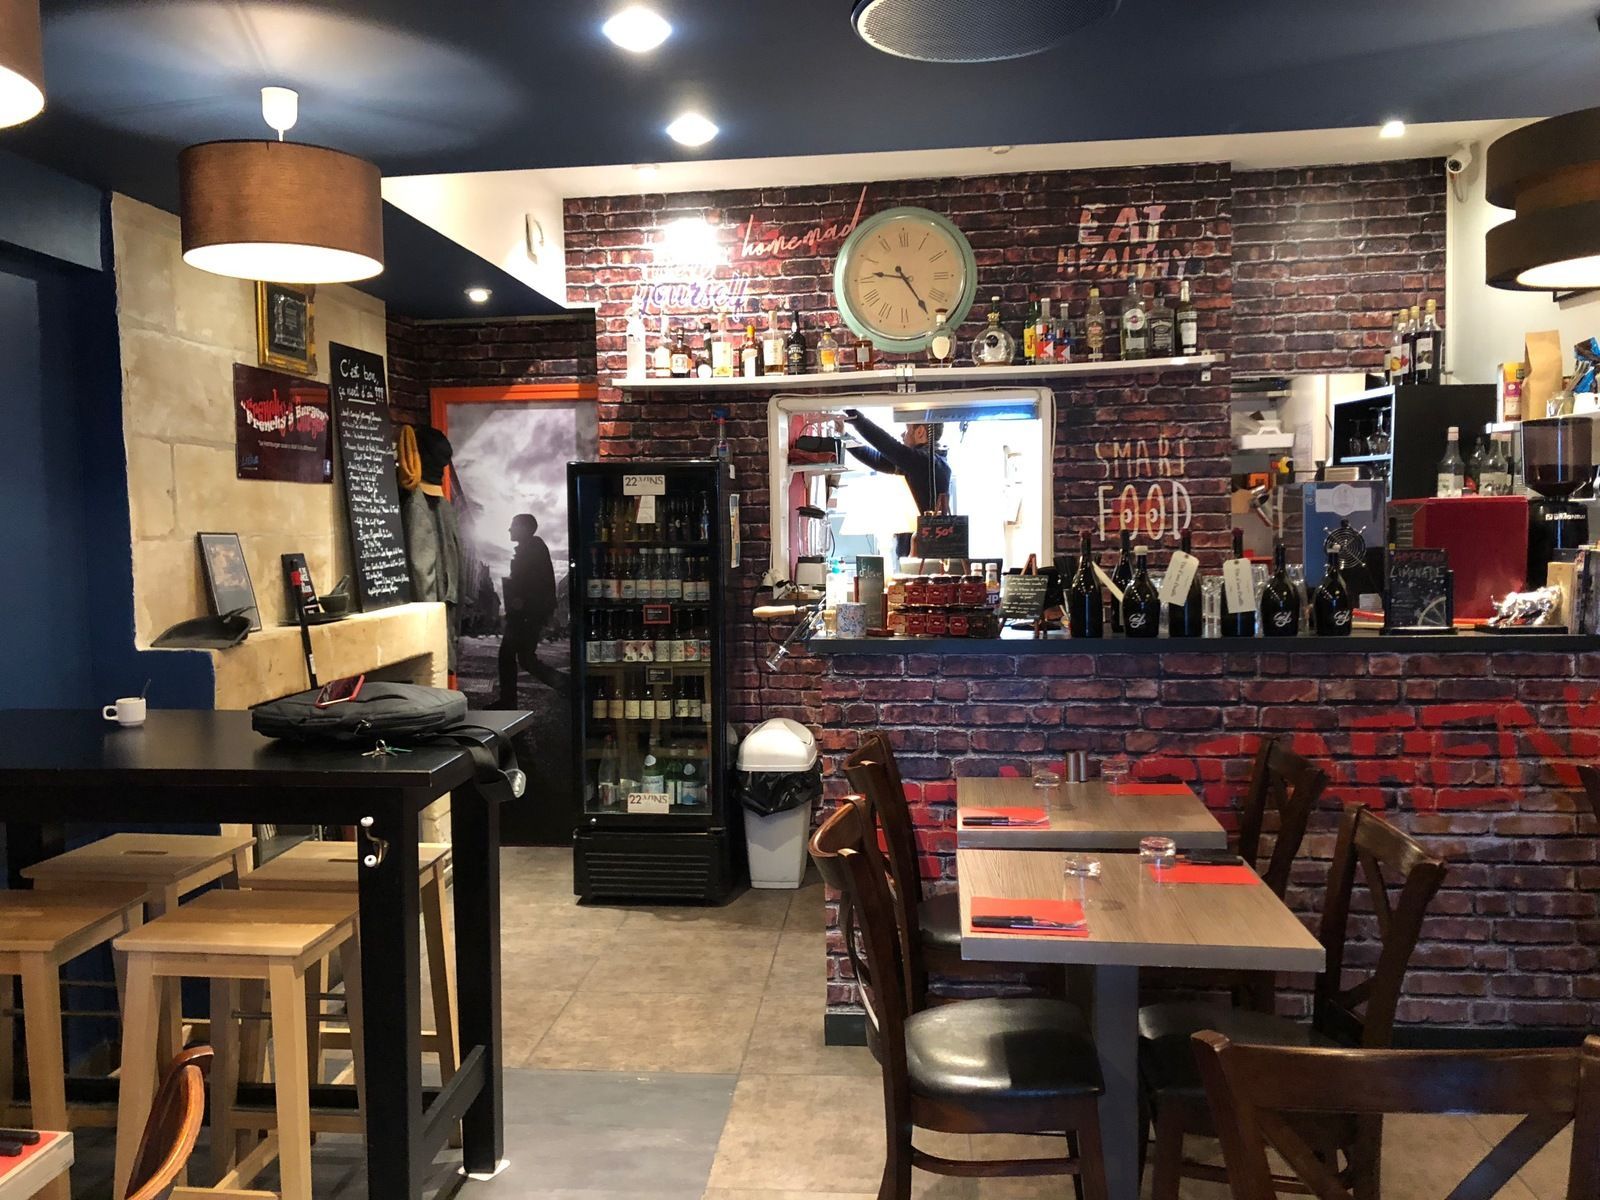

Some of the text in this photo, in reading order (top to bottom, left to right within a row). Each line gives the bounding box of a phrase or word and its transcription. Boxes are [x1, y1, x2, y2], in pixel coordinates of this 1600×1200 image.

[741, 185, 869, 257] homemad
[1078, 205, 1167, 245] EAT
[634, 270, 750, 322] yourself
[339, 358, 361, 379] C'est
[1094, 436, 1189, 478] SMART
[625, 476, 638, 487] 22
[1098, 481, 1192, 541] FOOD
[629, 794, 642, 805] 22
